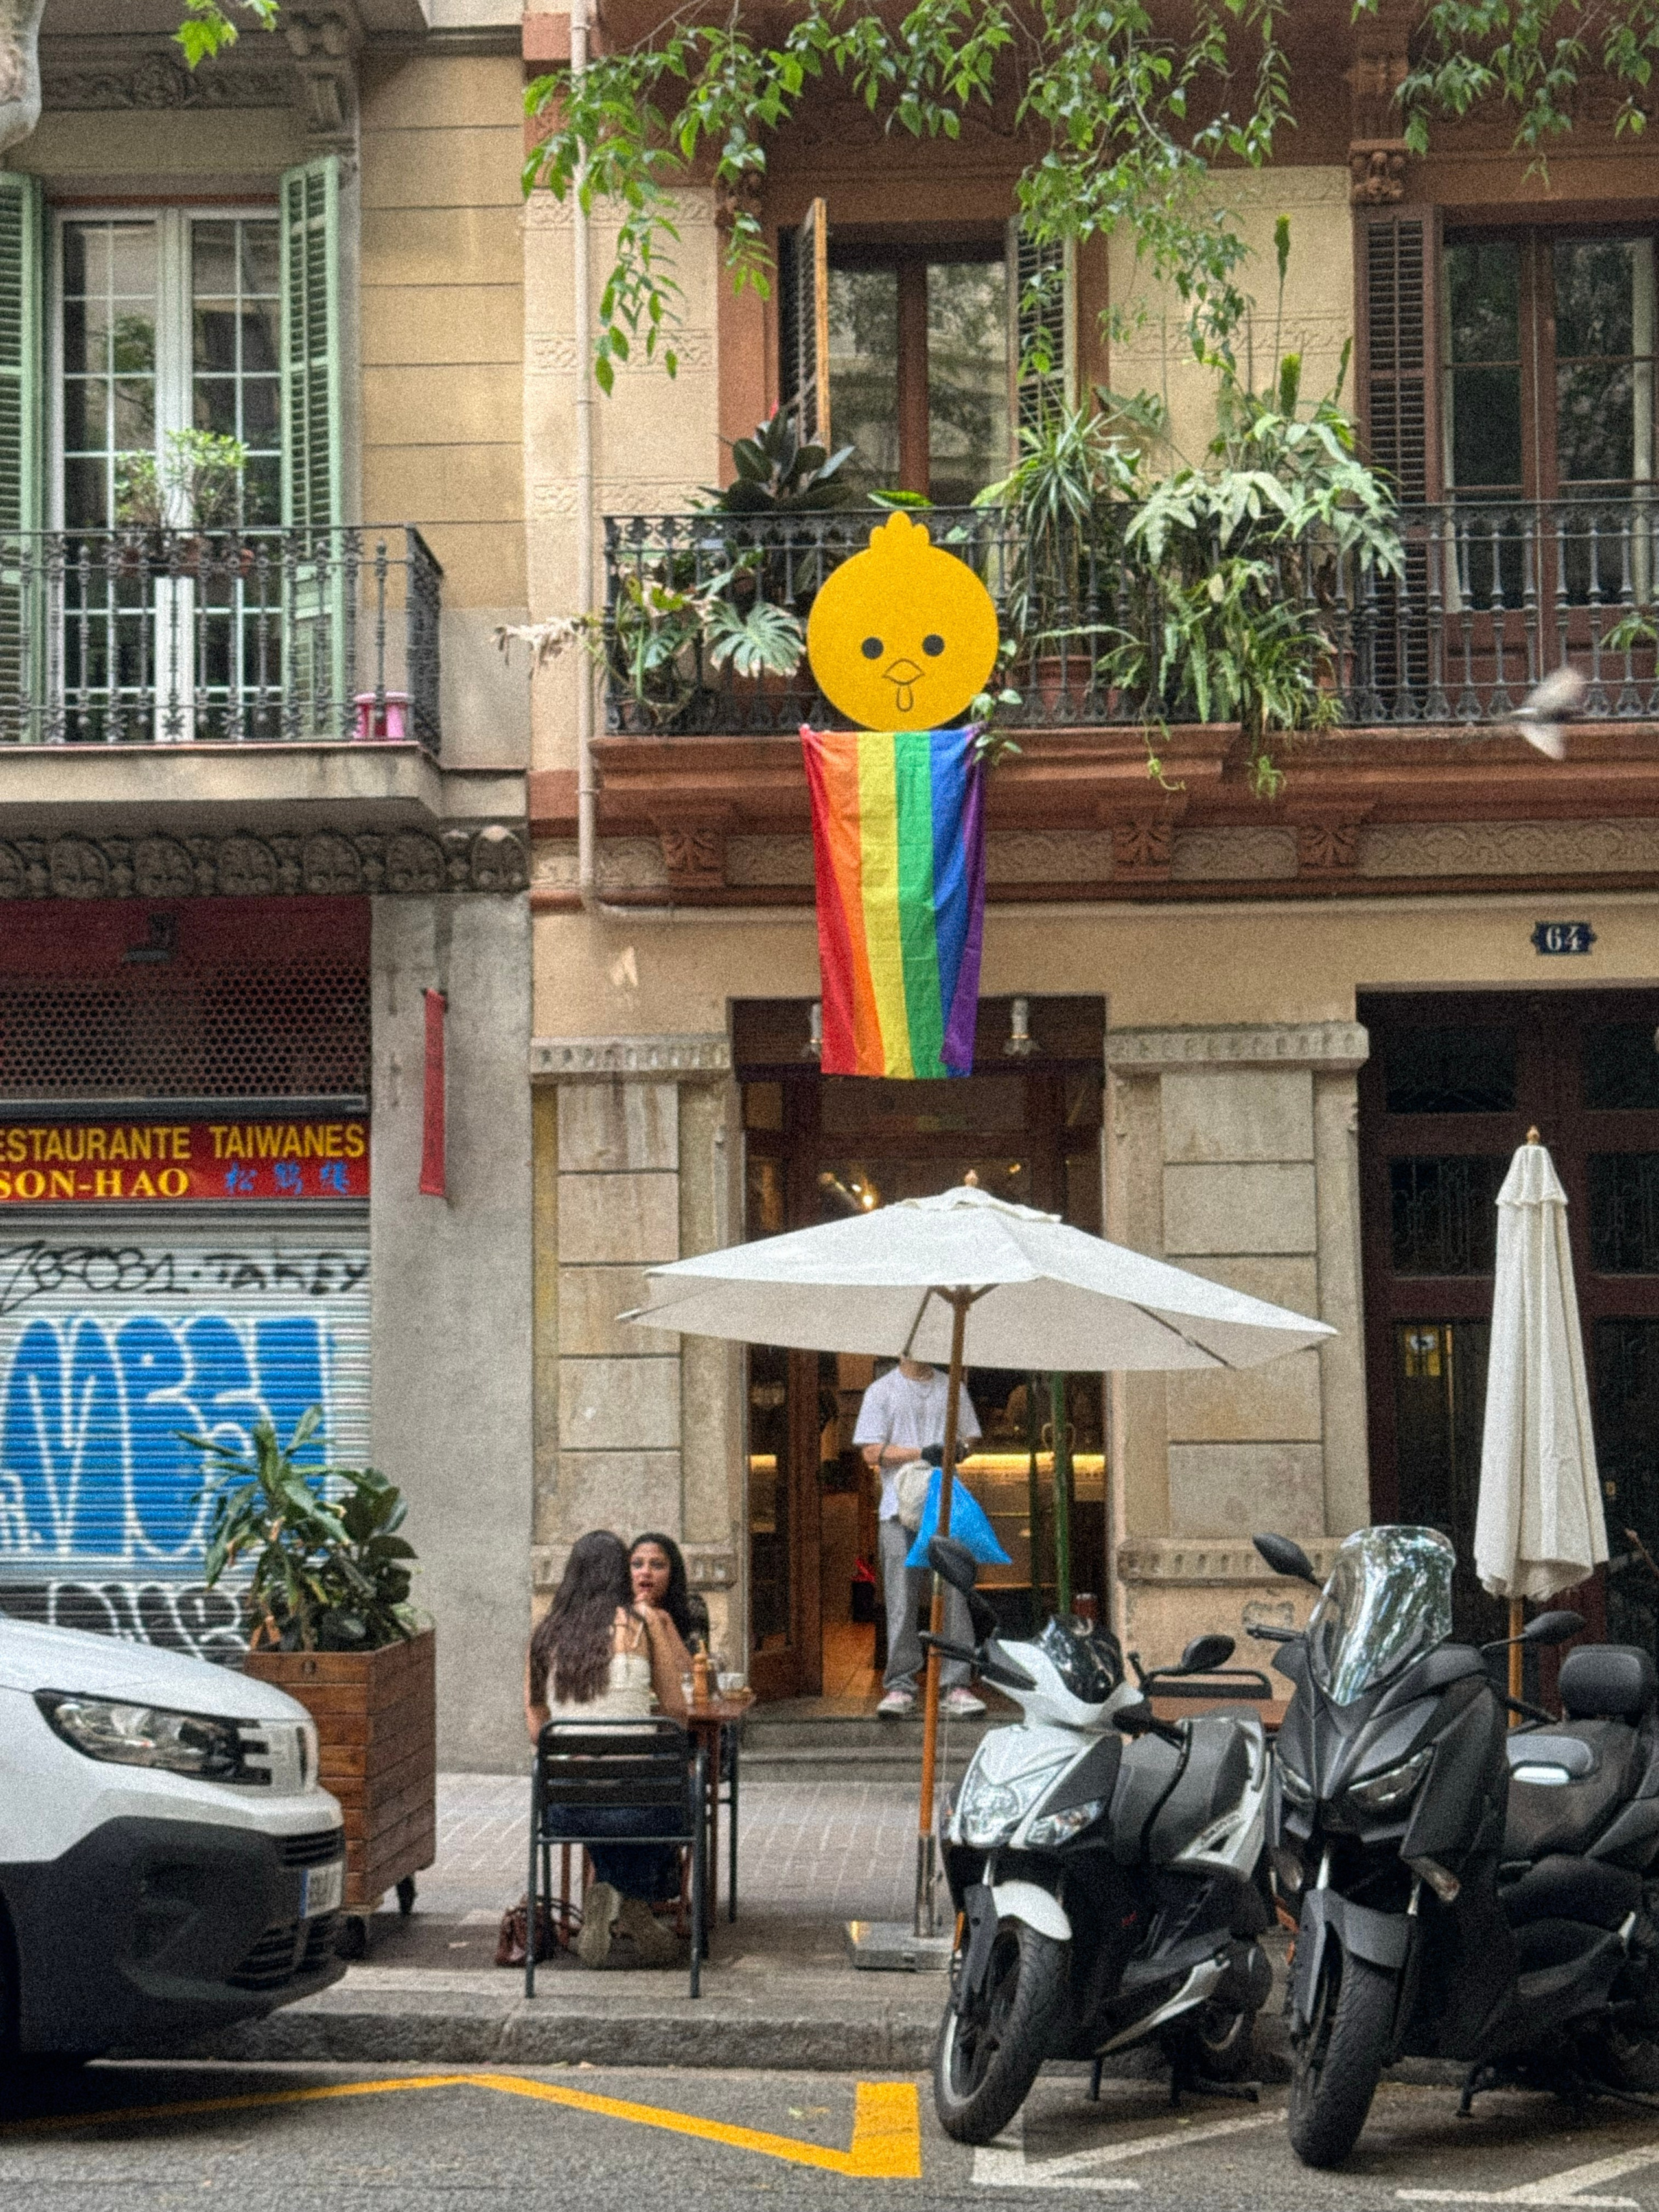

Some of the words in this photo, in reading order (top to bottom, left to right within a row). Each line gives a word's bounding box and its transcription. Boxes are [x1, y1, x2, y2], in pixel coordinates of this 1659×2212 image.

[1546, 926, 1583, 951] 64
[209, 1124, 365, 1158] TAIWANES
[0, 1169, 190, 1199] SON-HAO
